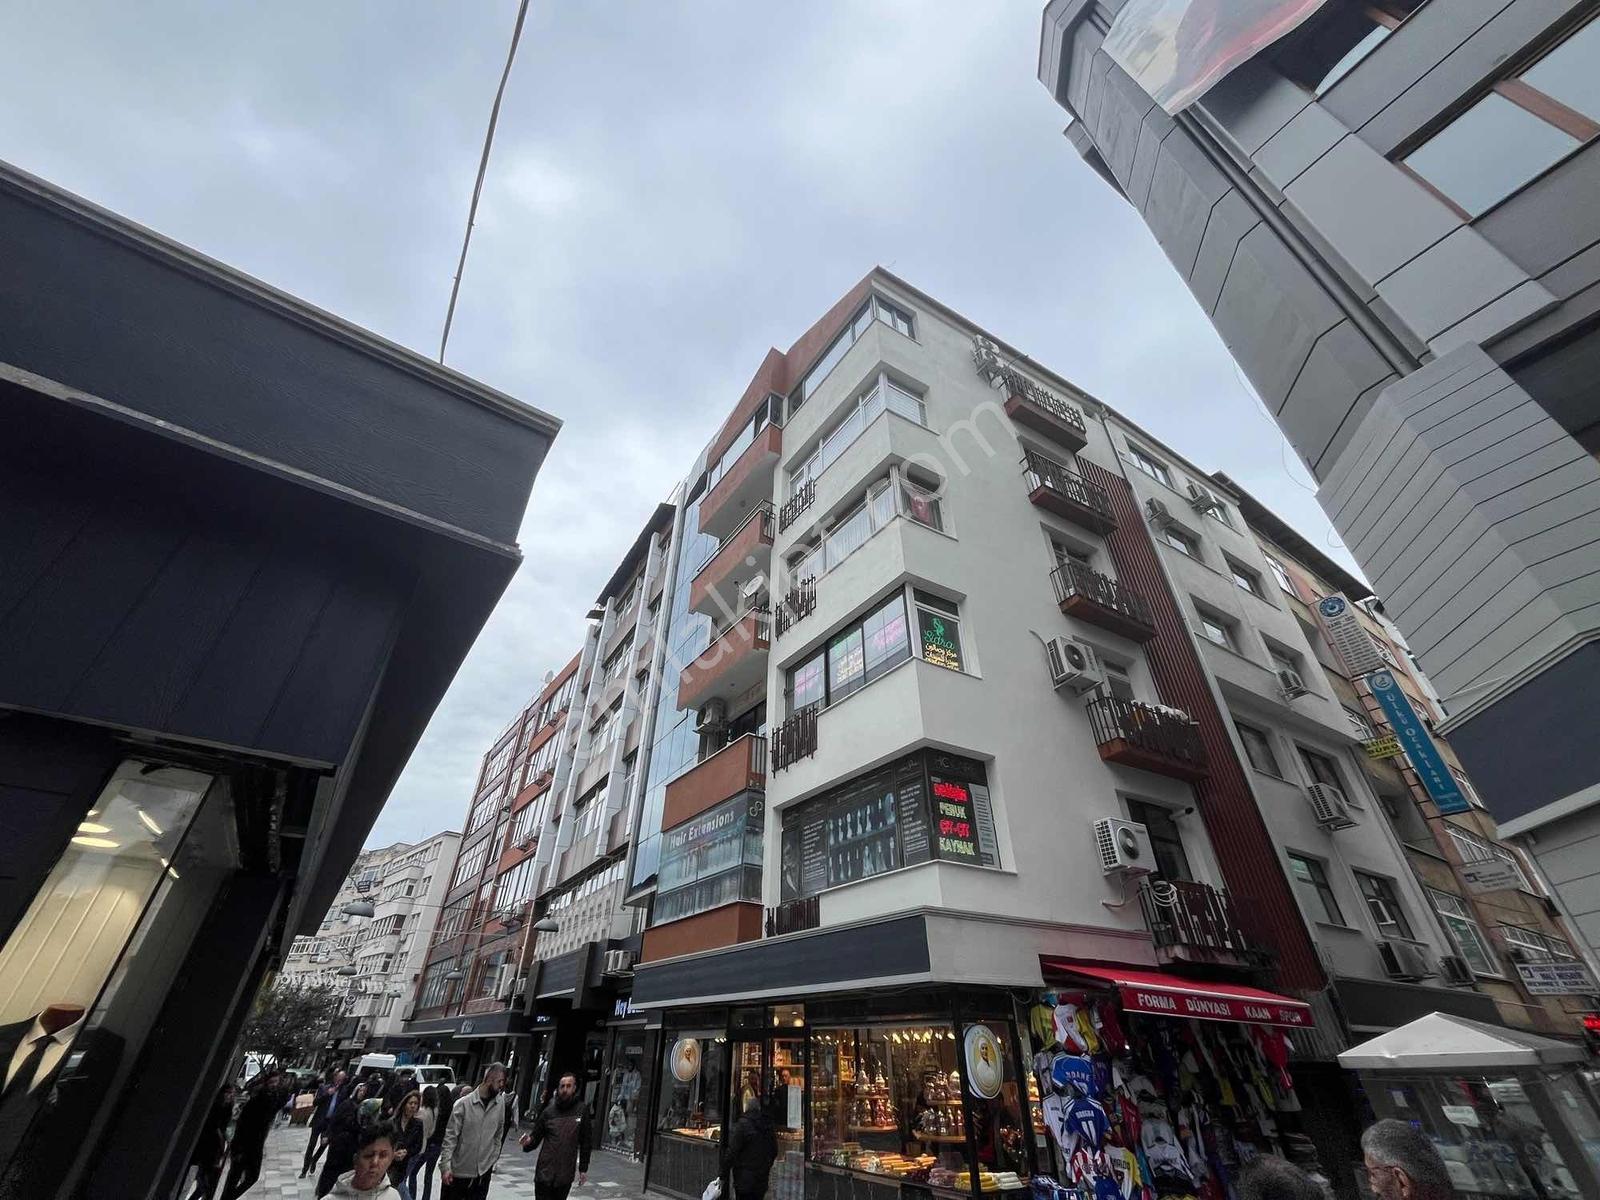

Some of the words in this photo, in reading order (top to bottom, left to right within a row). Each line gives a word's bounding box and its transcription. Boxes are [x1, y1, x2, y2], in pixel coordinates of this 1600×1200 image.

[669, 831, 687, 849] Hair
[688, 810, 735, 841] Extensions
[938, 836, 976, 856] KAYNAK
[1137, 993, 1177, 1011] FORMA
[1185, 997, 1232, 1017] DÜNYASI
[1243, 1006, 1272, 1021] KAAN
[1081, 1120, 1098, 1146] 11
